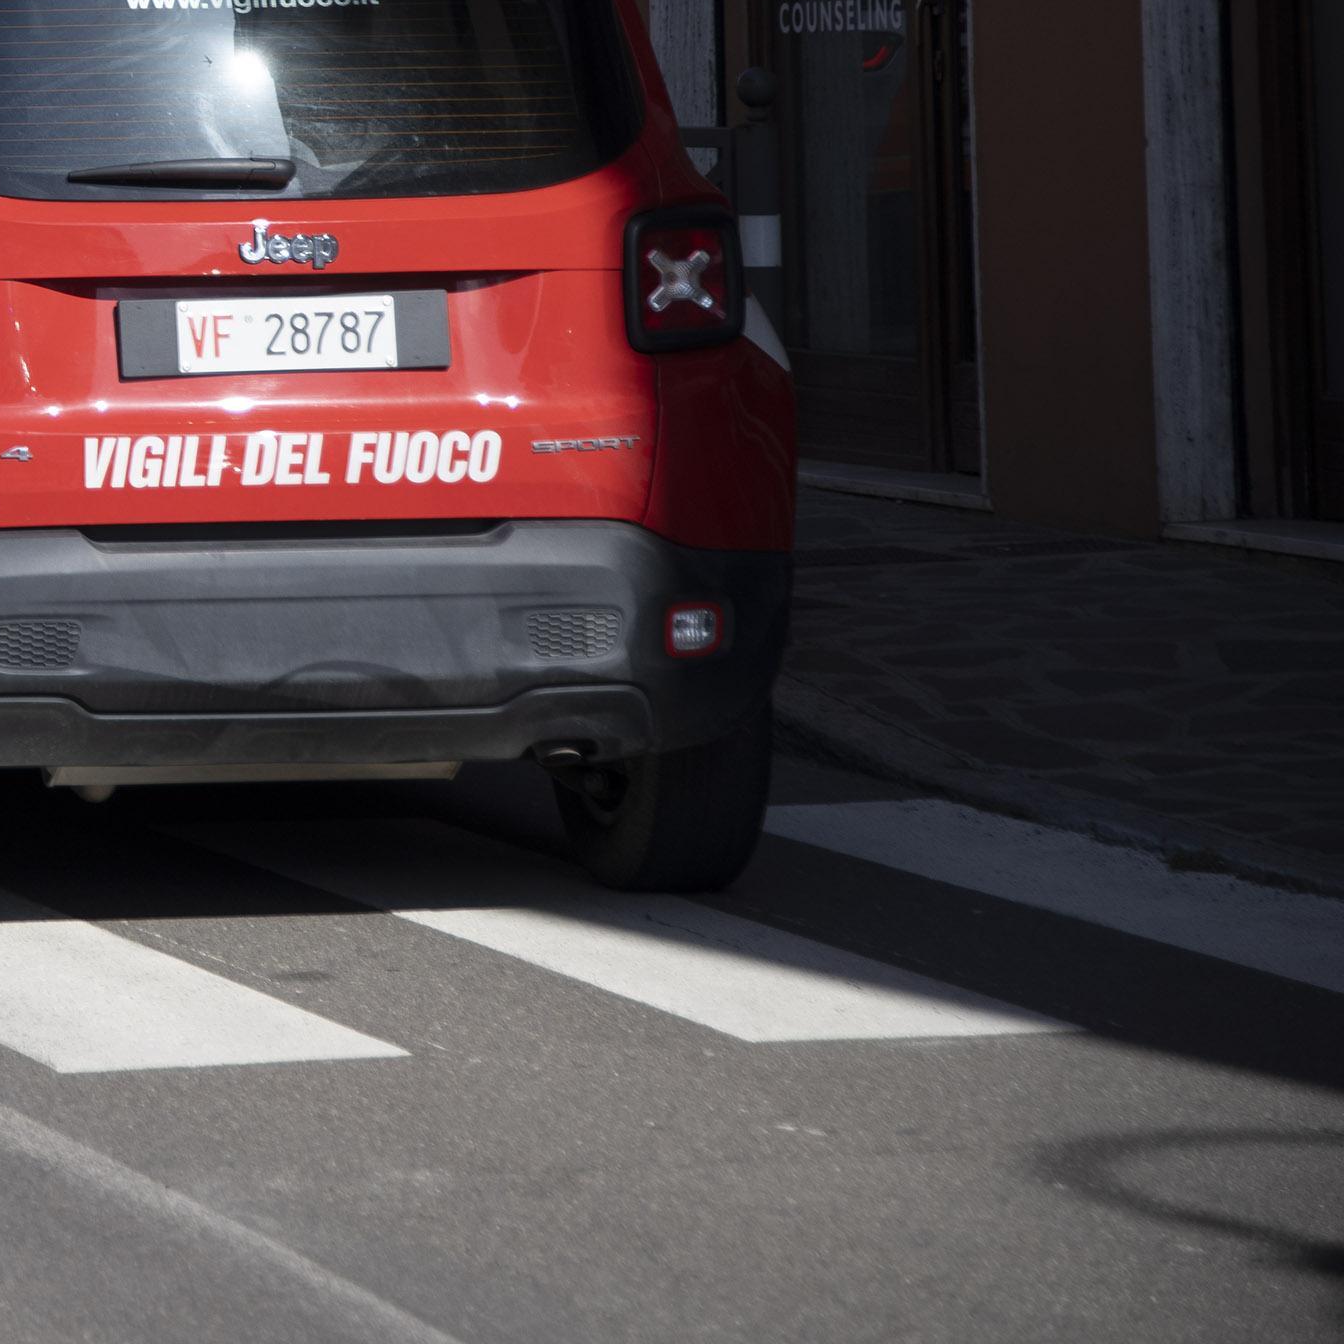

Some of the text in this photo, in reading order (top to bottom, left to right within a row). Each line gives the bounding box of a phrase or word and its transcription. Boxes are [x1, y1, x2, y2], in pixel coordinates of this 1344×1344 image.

[239, 220, 339, 270] Jeep
[187, 311, 385, 358] VF 28787
[84, 430, 502, 489] VIGILI DEL FUOCO
[531, 435, 641, 454] SPORT
